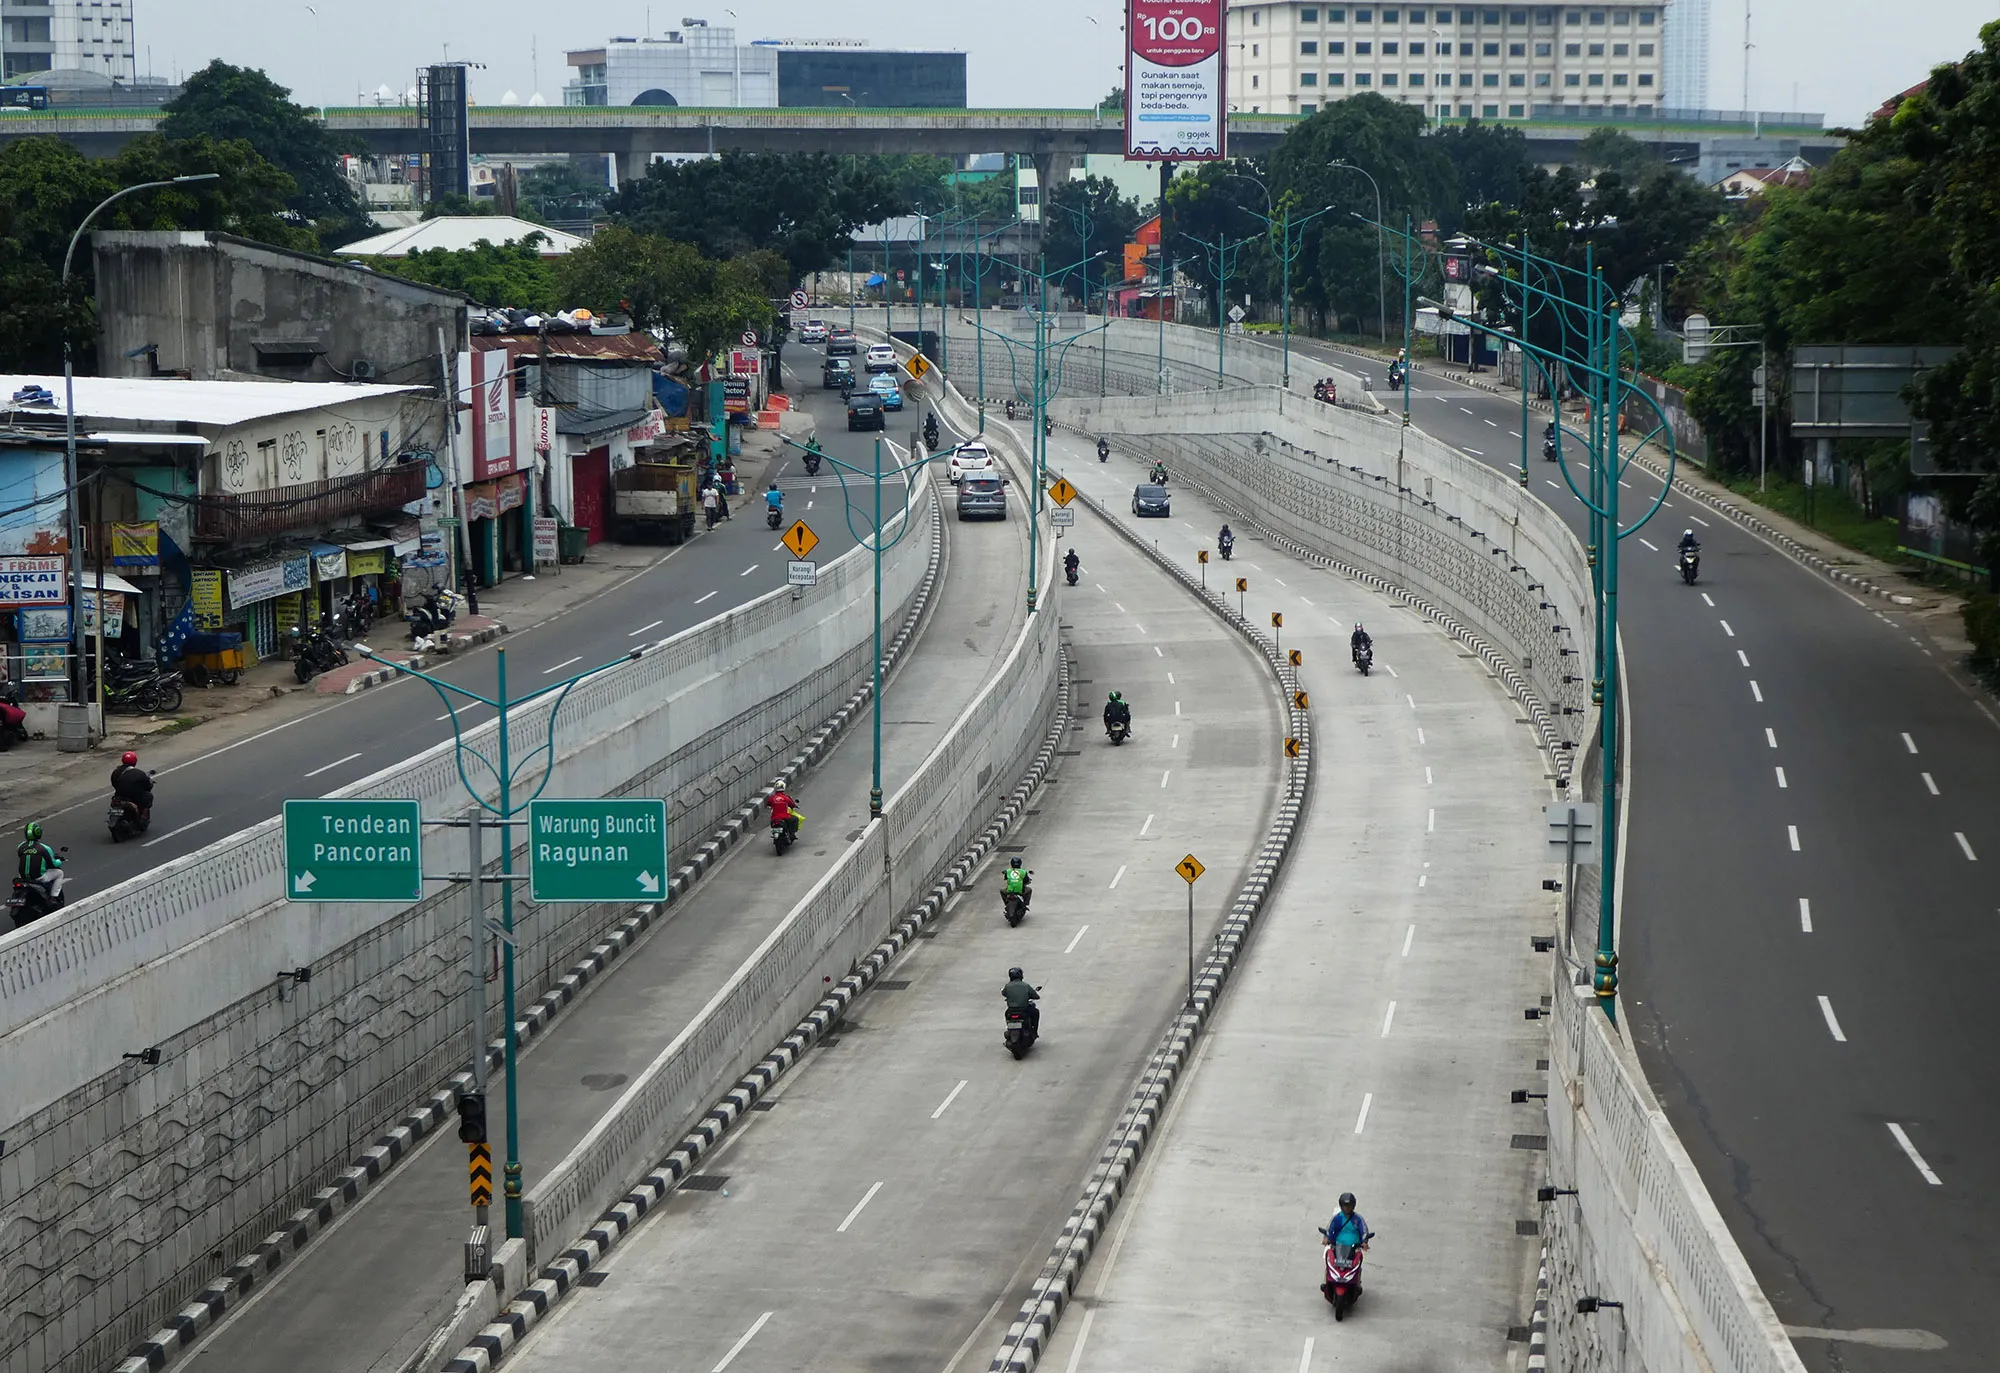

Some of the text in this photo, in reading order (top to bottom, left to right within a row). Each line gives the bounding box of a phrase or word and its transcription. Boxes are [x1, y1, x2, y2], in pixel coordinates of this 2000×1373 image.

[1143, 17, 1203, 40] 100
[1171, 82, 1205, 91] semeja,
[1141, 92, 1208, 101] tapi pengennya
[1186, 131, 1211, 140] gojek
[9, 560, 58, 572] FRAME
[792, 566, 812, 574] Kurangi
[0, 573, 56, 584] NGKAI
[12, 583, 21, 591] &
[0, 590, 59, 599] KISAN
[322, 814, 410, 834] Tendean
[539, 813, 657, 839] Warung Buncit
[314, 843, 411, 862] Pancoran
[539, 843, 629, 867] Ragunan
